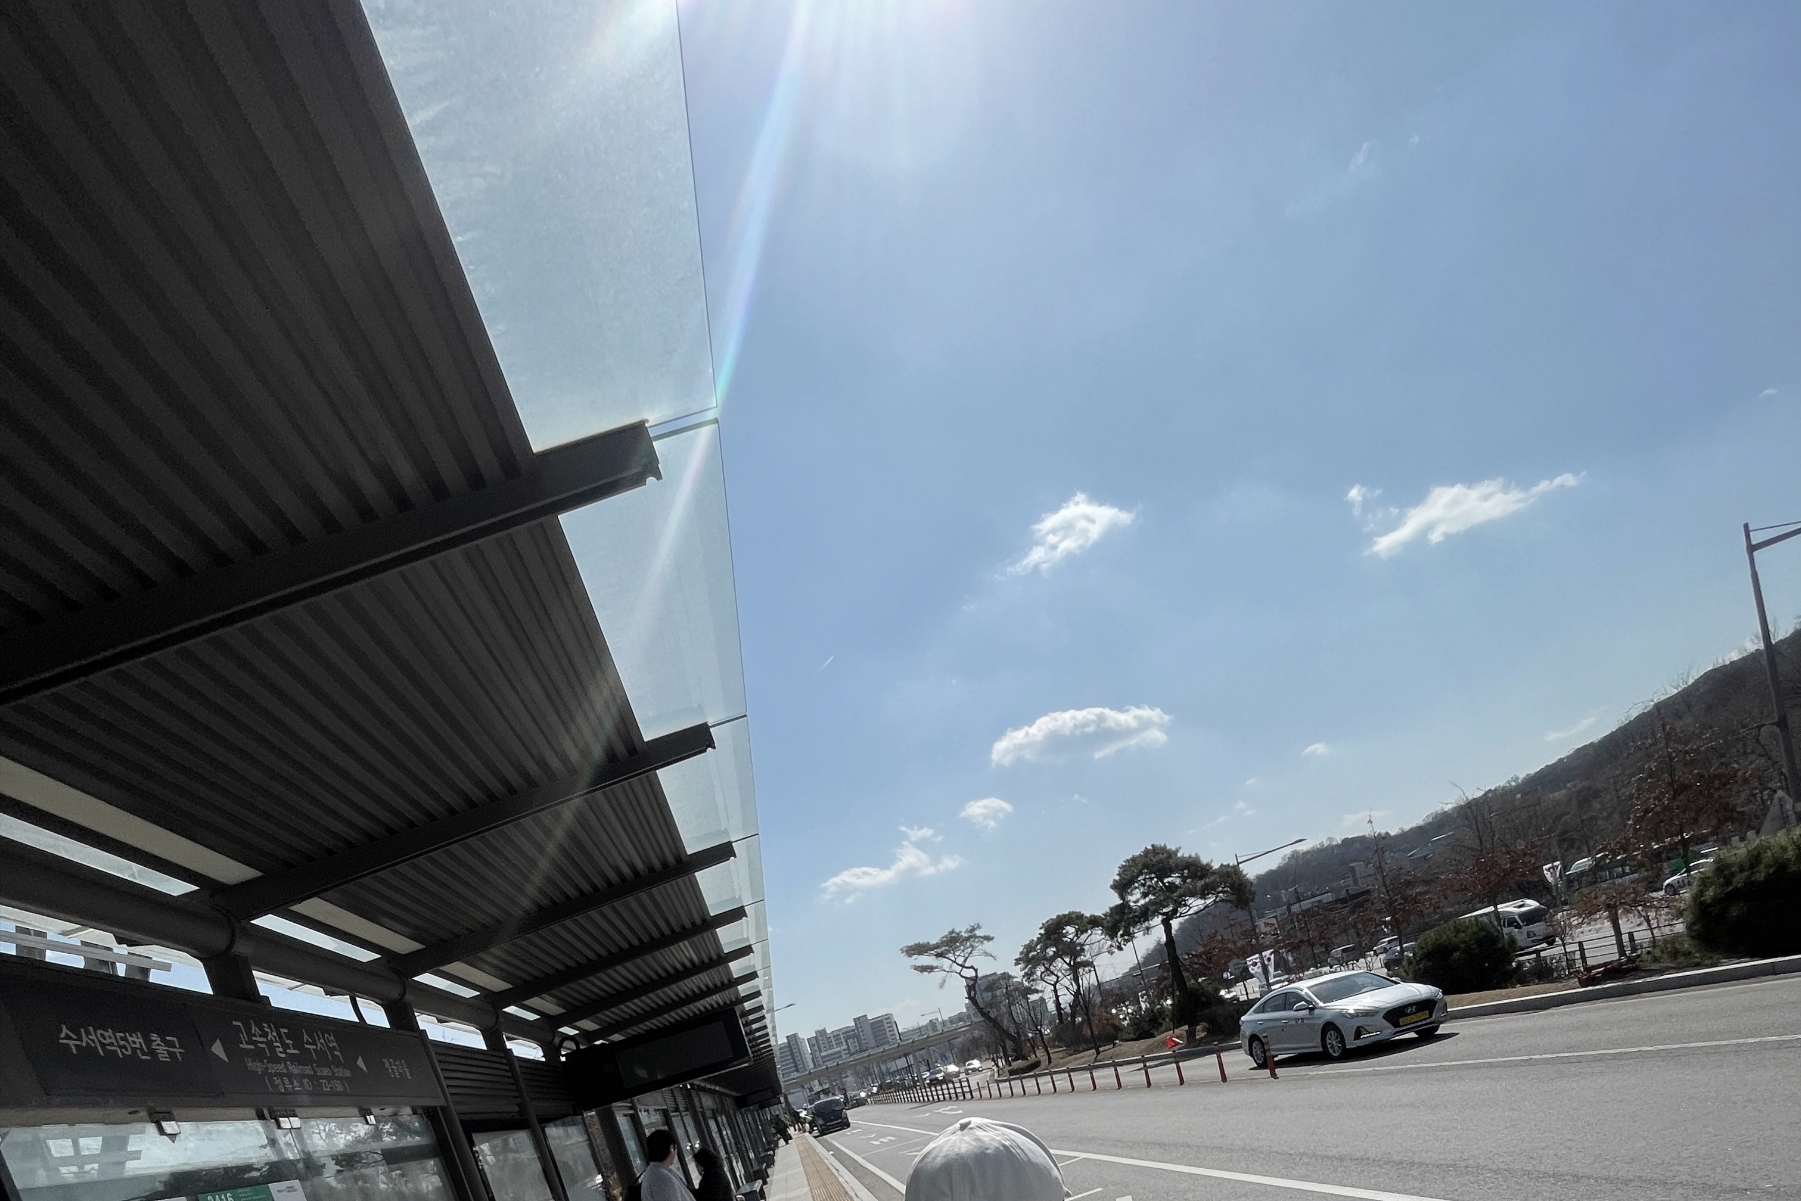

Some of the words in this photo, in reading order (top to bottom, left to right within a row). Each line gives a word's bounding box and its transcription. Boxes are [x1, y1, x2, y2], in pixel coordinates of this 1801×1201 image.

[58, 1023, 151, 1060] 수서역5번
[150, 1033, 185, 1062] 출구
[232, 1020, 300, 1058] 고속철도
[302, 1029, 345, 1064] 수서역
